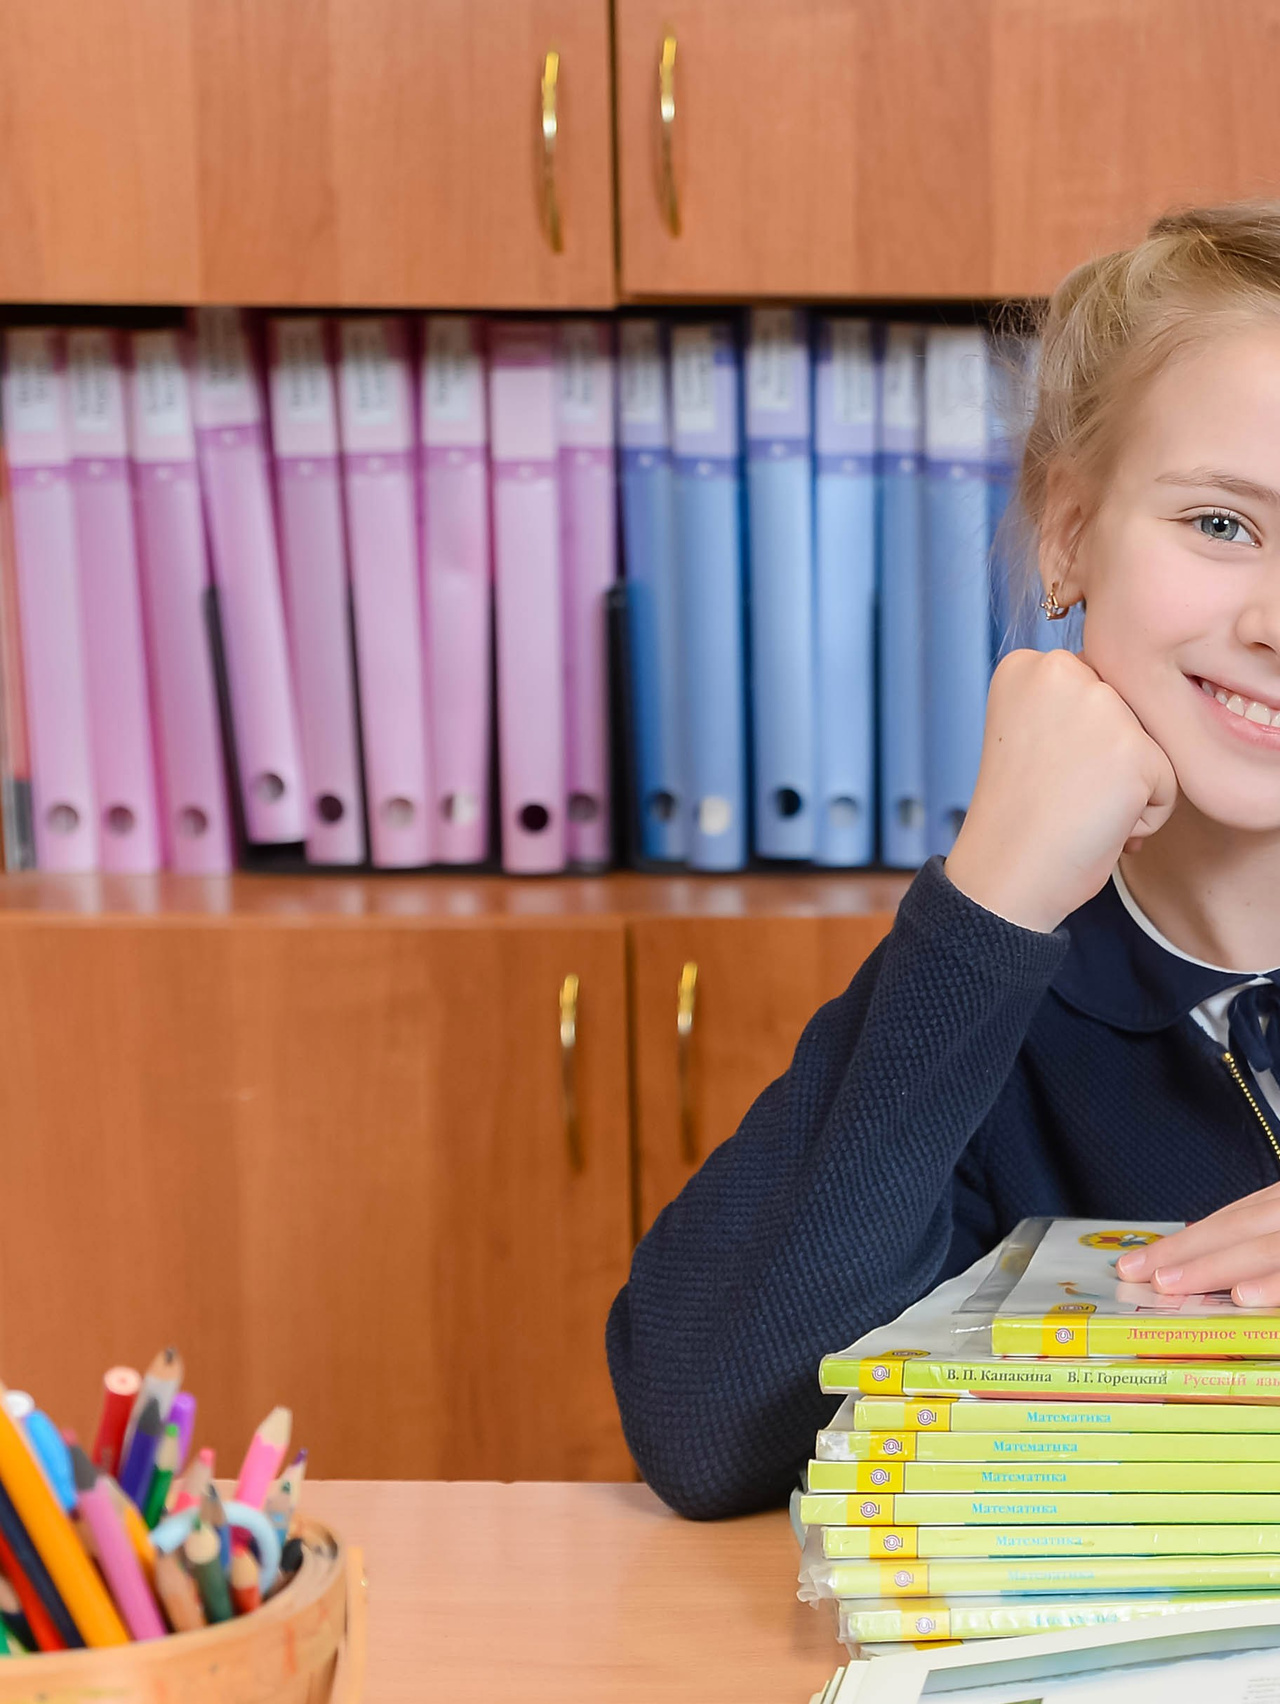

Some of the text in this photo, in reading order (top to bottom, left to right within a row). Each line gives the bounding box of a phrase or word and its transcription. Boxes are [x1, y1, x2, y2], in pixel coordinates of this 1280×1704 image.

[1127, 1327, 1237, 1343] Литературное
[947, 1369, 1052, 1382] В. П. Канакина
[1067, 1371, 1168, 1388] В. Г. Горецкий
[1183, 1373, 1247, 1388] Русский
[1027, 1410, 1111, 1423] Математика
[993, 1439, 1078, 1452] Математика
[981, 1471, 1067, 1483] Математика
[971, 1502, 1057, 1515] Математика
[996, 1534, 1082, 1547] Математика
